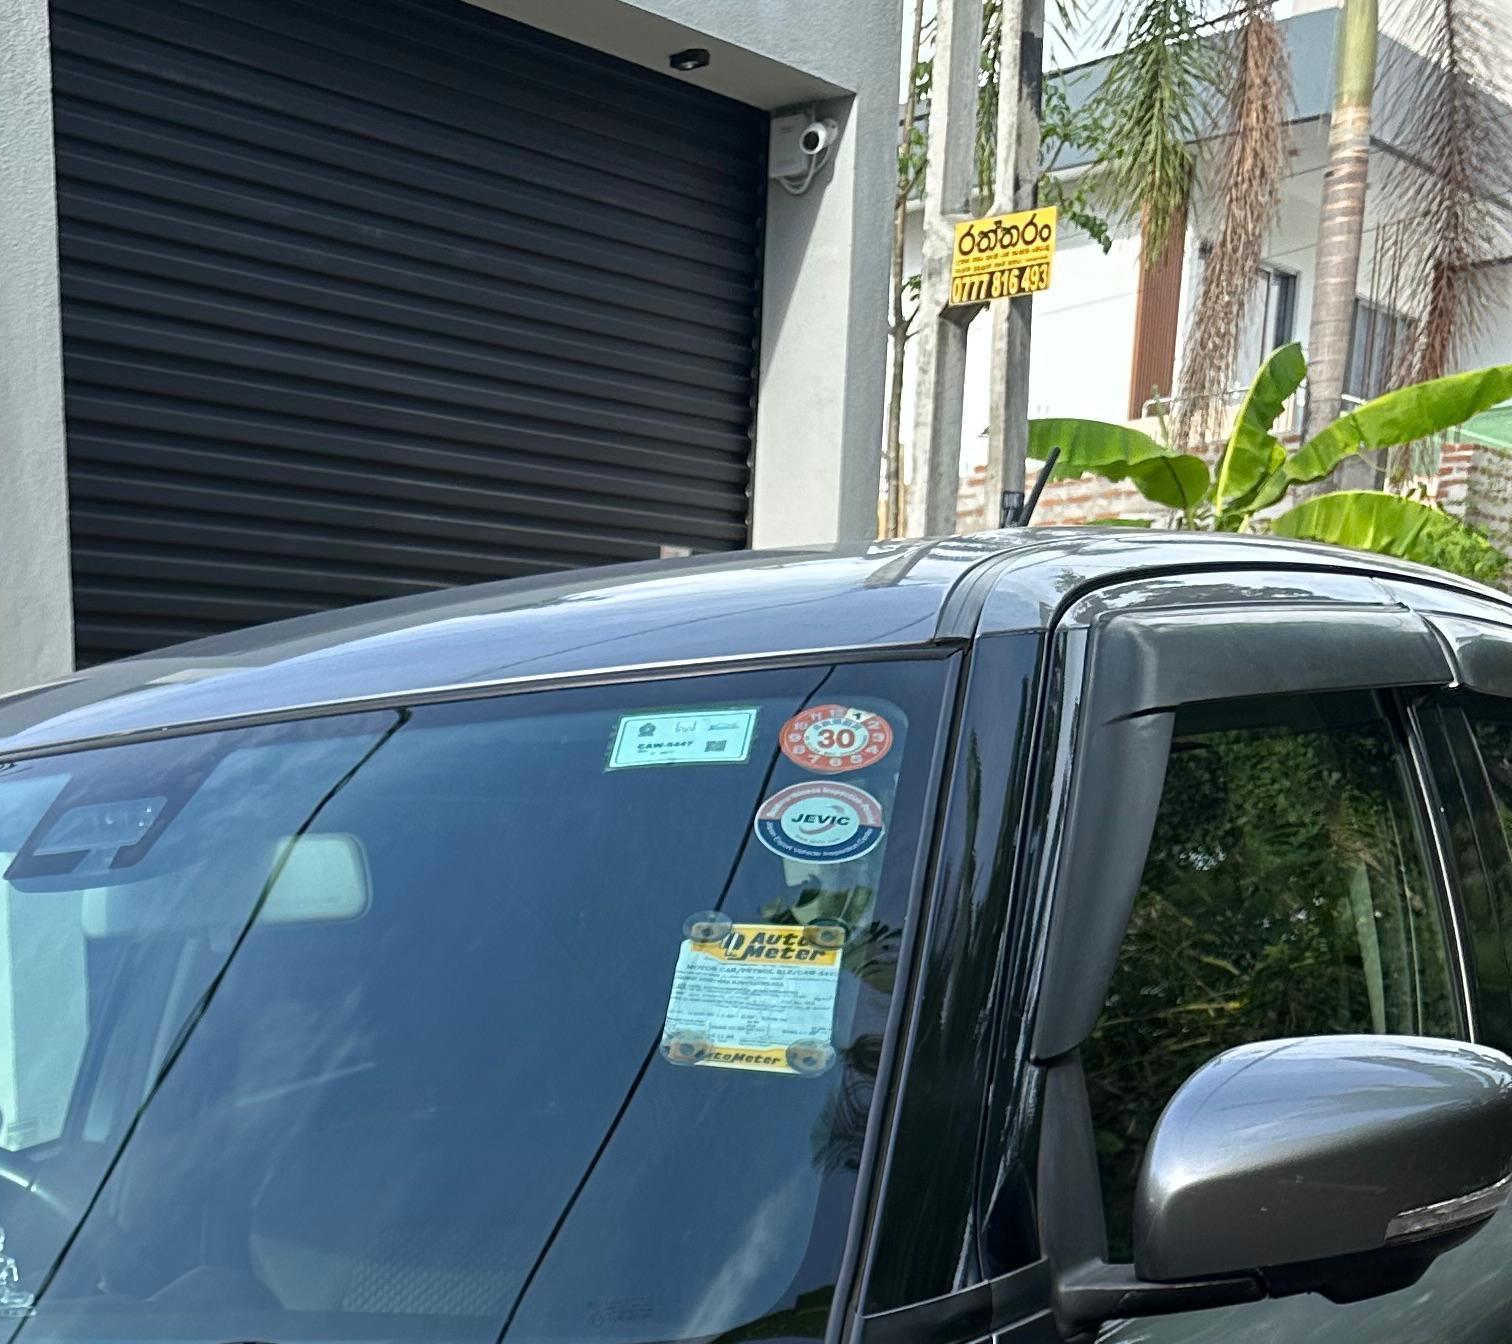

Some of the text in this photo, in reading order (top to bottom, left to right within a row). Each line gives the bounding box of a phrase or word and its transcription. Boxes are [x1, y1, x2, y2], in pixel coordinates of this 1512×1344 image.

[952, 273, 990, 303] 0777
[991, 268, 1020, 297] 816
[1021, 264, 1048, 292] 493
[817, 729, 856, 749] 30
[791, 814, 850, 825] JEVIC
[744, 945, 826, 960] Meter
